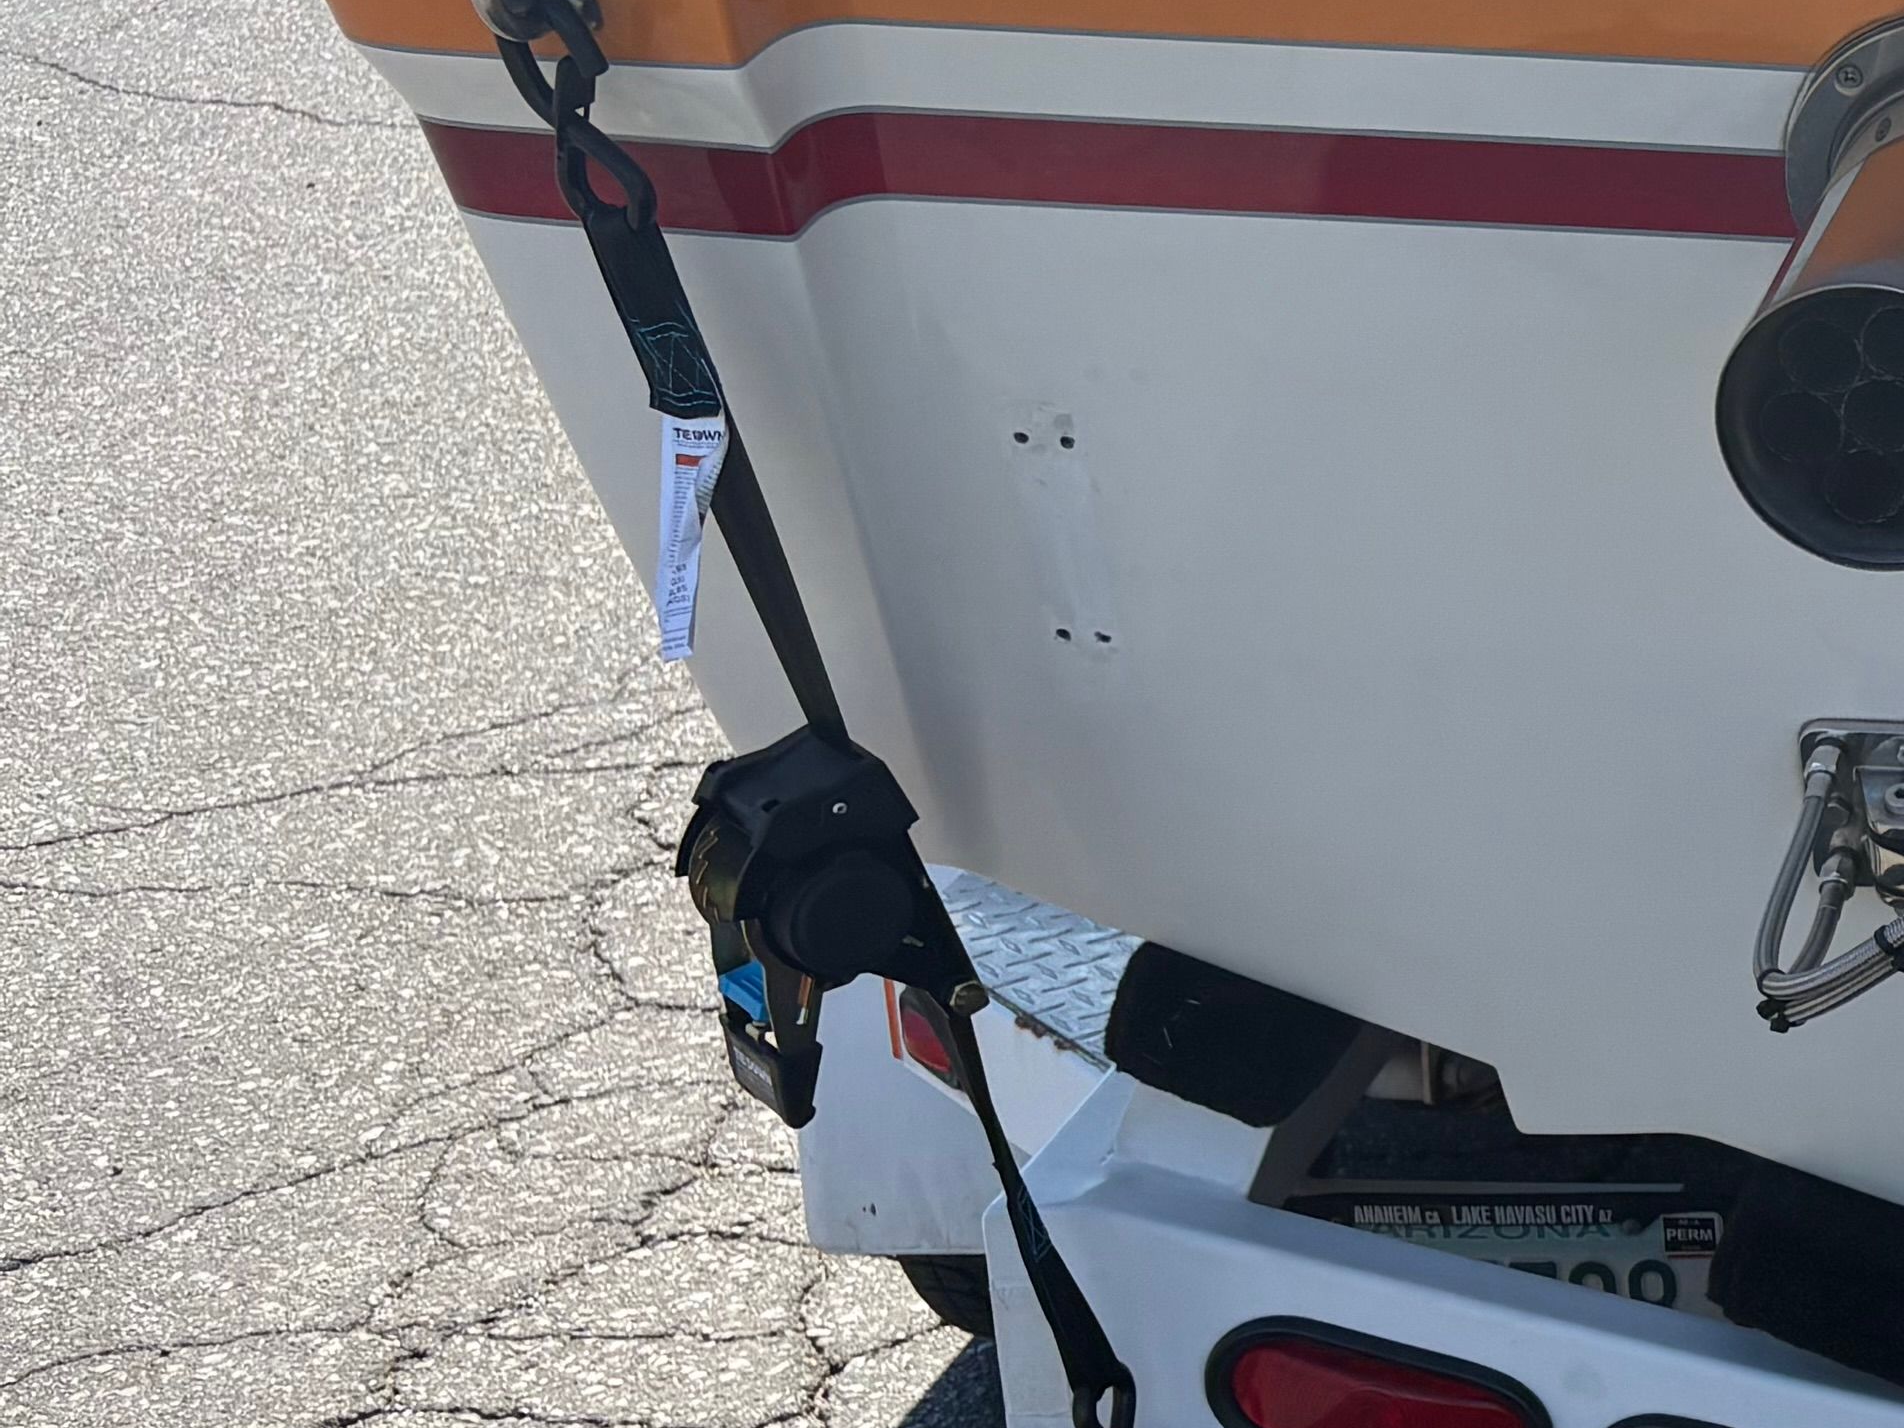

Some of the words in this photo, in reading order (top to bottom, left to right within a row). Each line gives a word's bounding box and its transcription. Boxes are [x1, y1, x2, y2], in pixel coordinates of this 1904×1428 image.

[1353, 1204, 1422, 1224] ANAHEIM
[1451, 1205, 1491, 1224] LAKE
[1494, 1204, 1557, 1224] HAVASU
[1560, 1204, 1594, 1224] CITY
[1666, 1227, 1714, 1242] PERM
